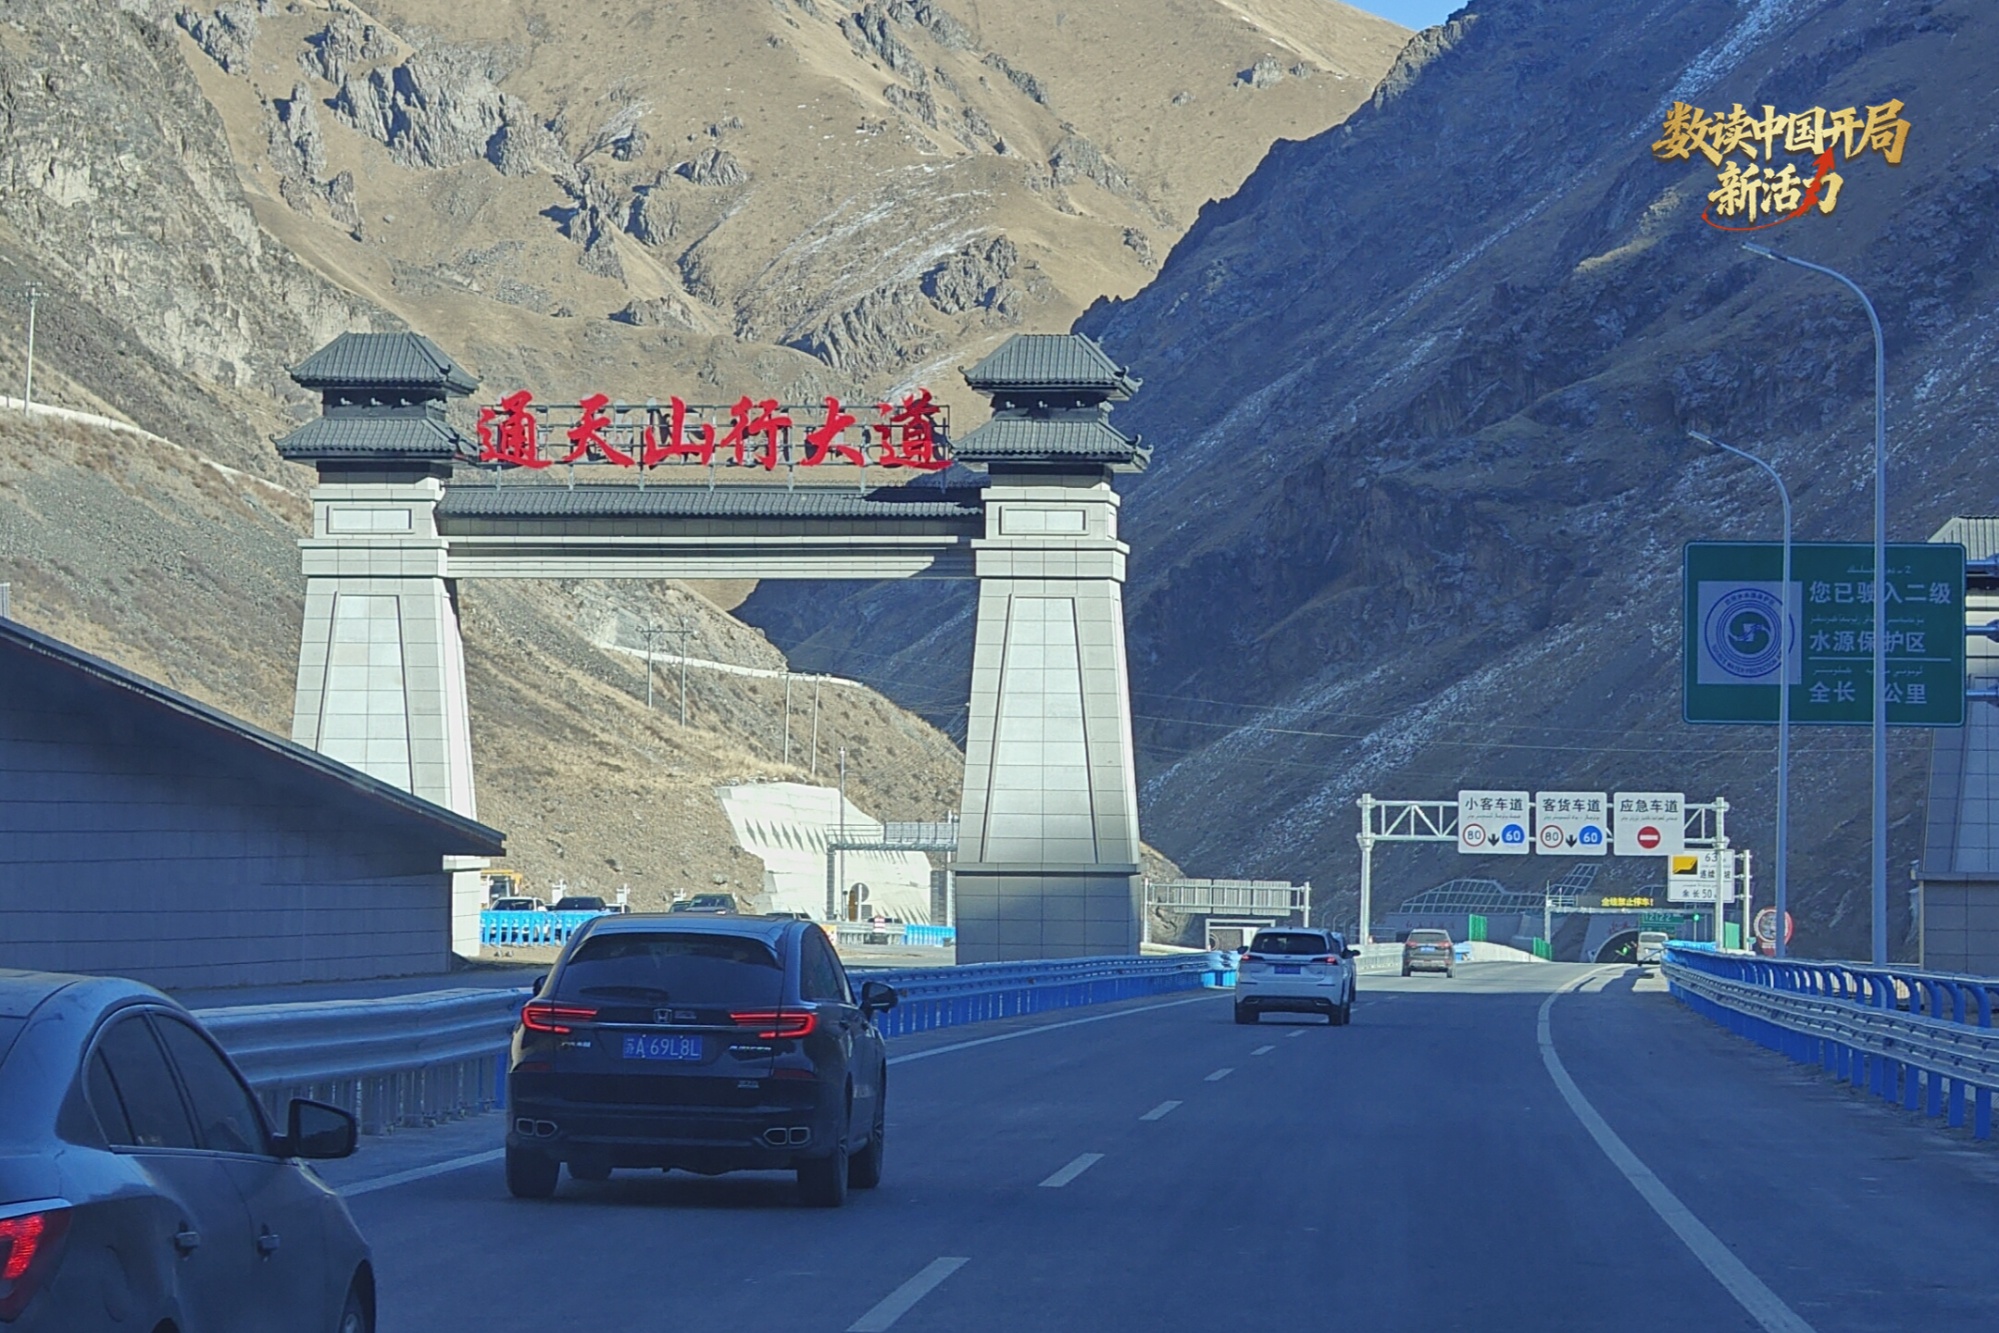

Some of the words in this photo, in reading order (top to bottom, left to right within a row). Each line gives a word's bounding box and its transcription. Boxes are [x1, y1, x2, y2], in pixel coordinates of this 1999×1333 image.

[477, 387, 953, 470] 通天山行大道
[1809, 580, 1951, 604] 您已驶入二级
[1809, 630, 1926, 653] 水源保护区
[1809, 681, 1856, 702] 全长
[1884, 682, 1927, 704] 公里
[1465, 797, 1523, 812] 小客车道
[1542, 798, 1601, 813] 客货车道
[1619, 799, 1679, 814] 应急车道
[1467, 830, 1481, 840] 80
[1505, 830, 1521, 841] 60
[1544, 831, 1559, 842] 80
[1583, 831, 1598, 843] 60
